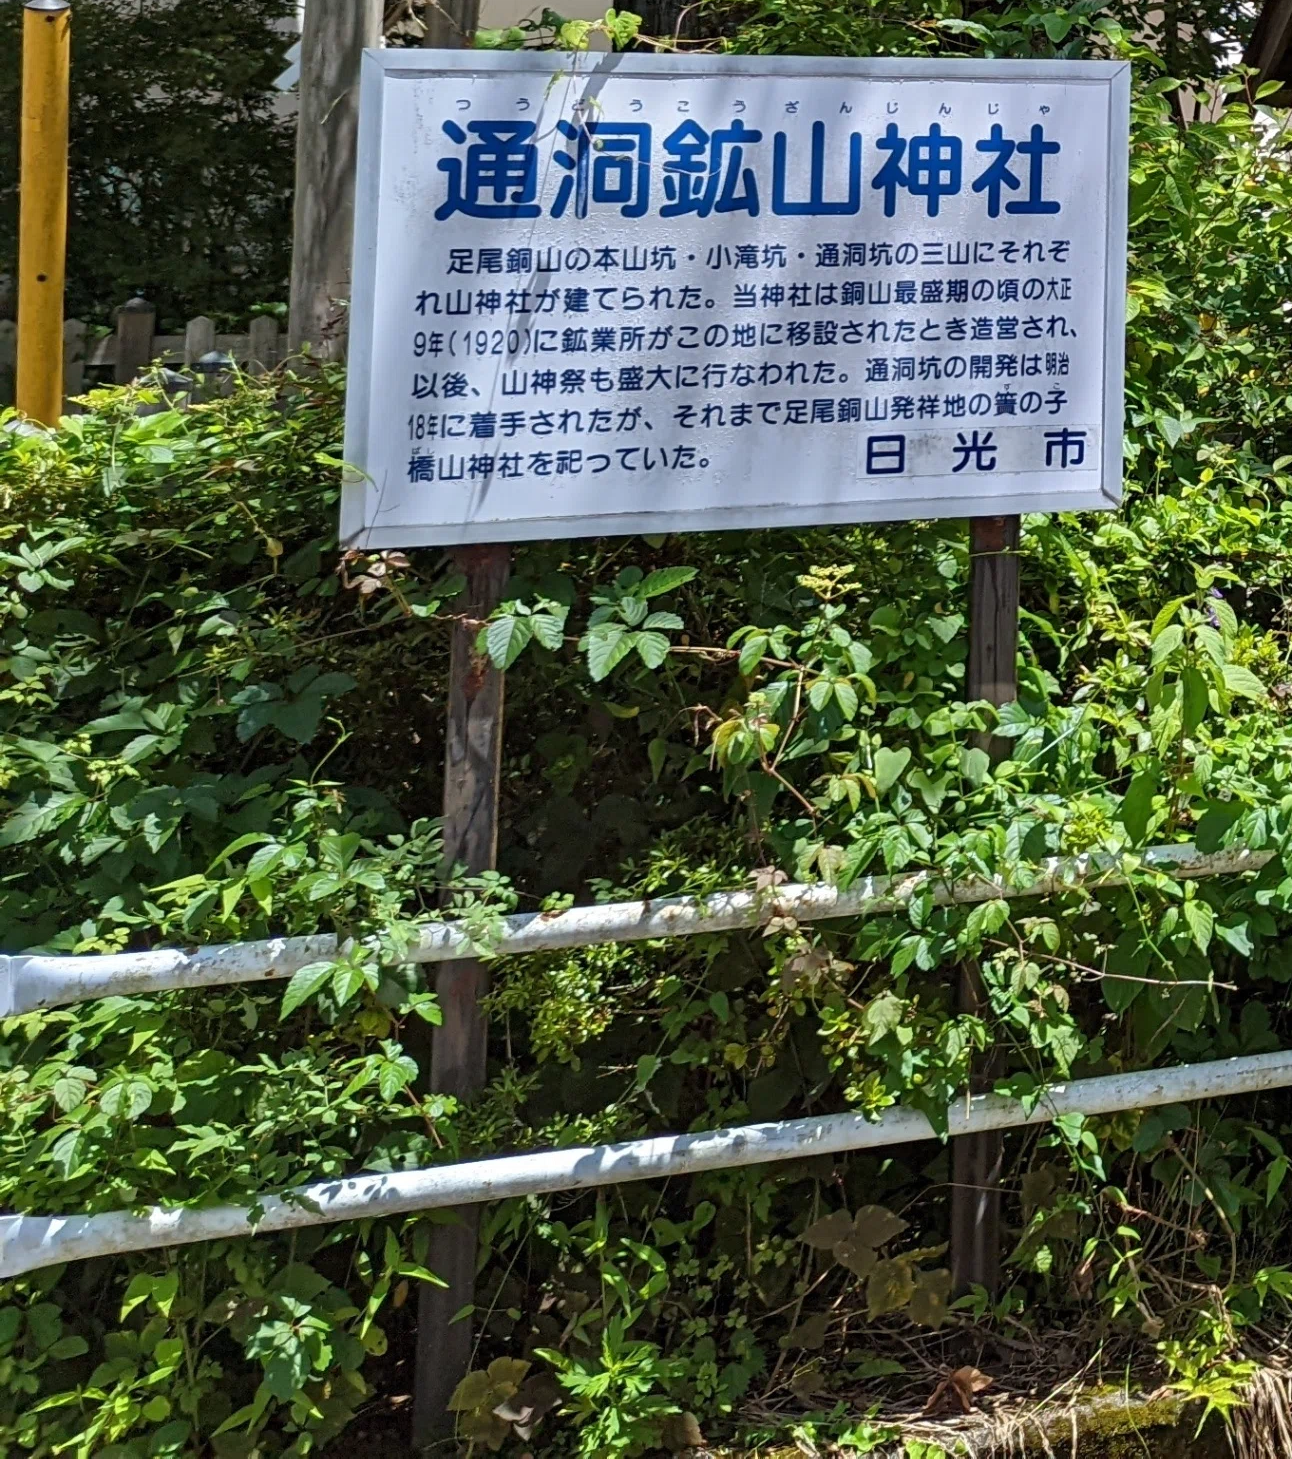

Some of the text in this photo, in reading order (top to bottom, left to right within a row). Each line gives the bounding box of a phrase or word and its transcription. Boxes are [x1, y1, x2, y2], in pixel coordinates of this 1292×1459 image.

[434, 119, 1061, 221] 通洞鉱山神社
[407, 445, 711, 483] 橋山神社を祀っていた。
[866, 427, 1087, 474] 日光市
